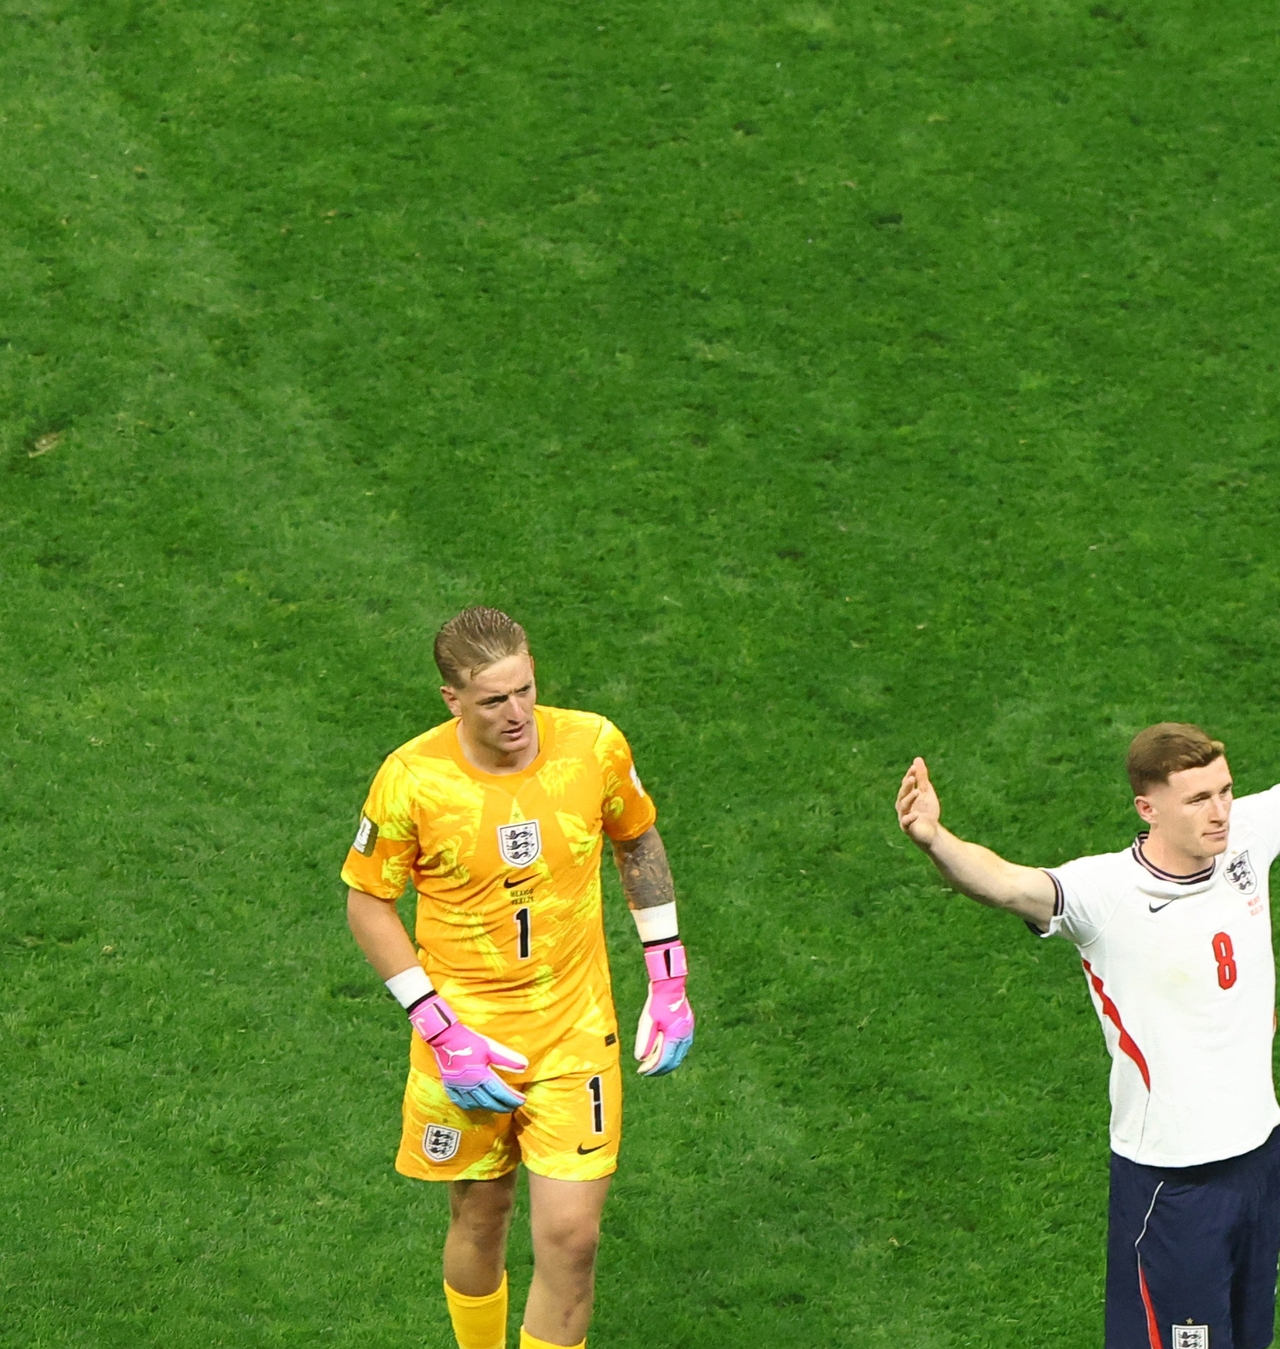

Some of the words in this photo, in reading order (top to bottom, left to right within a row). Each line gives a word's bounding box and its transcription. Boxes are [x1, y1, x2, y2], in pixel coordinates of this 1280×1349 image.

[514, 907, 531, 960] 1
[1211, 931, 1238, 991] 8
[587, 1075, 604, 1134] 1
